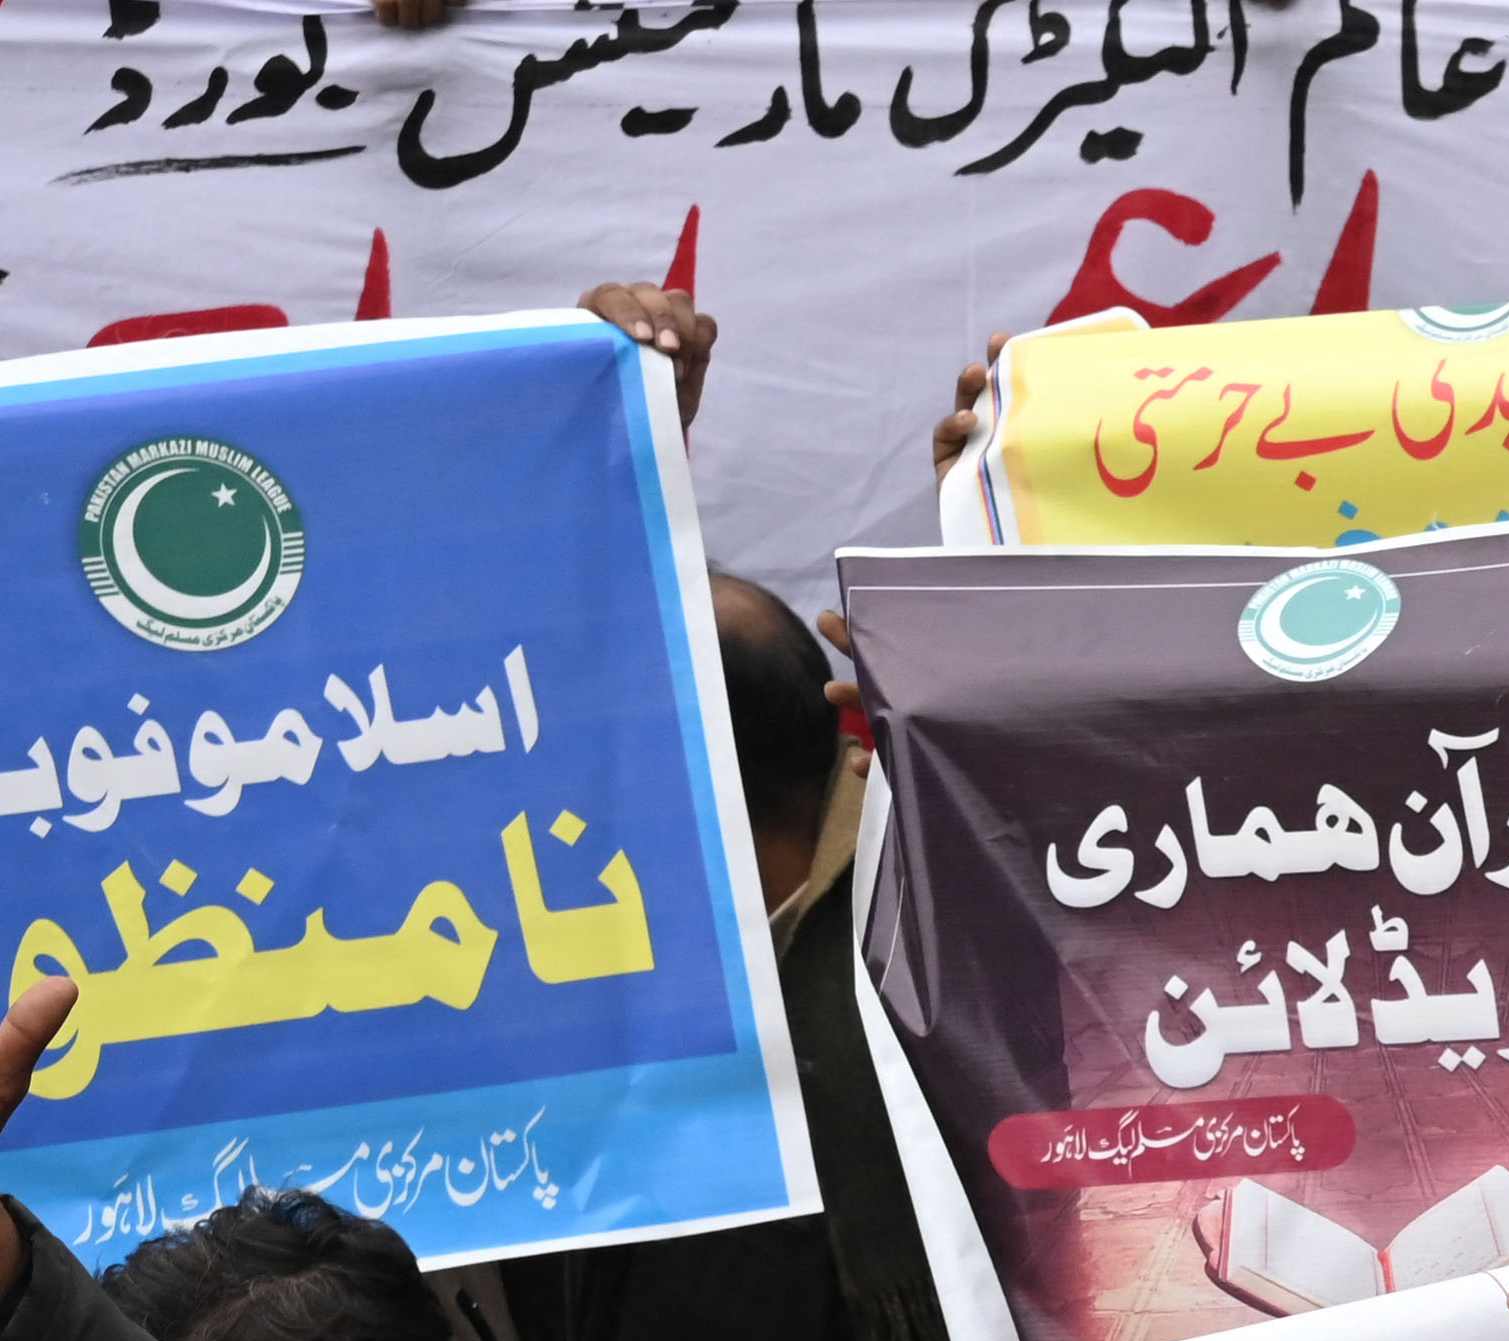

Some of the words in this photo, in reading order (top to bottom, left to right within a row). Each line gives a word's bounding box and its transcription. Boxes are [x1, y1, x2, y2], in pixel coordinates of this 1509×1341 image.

[1093, 364, 1262, 499] حرمتی
[1254, 382, 1377, 493] بے
[84, 460, 131, 524] PAKISTAN
[126, 439, 193, 471] MARKAZI
[196, 439, 255, 474] MUSLIM
[249, 464, 294, 515] LEAGUE
[0, 643, 540, 839] اسلاموفوب
[8, 808, 656, 1101] نامنظو
[1143, 929, 1360, 1091] لائن
[352, 1126, 445, 1221] مرکزی
[444, 1104, 560, 1210] پاکستان
[1040, 1123, 1087, 1164] لاہور
[1087, 1109, 1141, 1165] لیگ
[1128, 1116, 1204, 1178] مسلم
[1192, 1111, 1245, 1162] مرکزی
[1242, 1103, 1306, 1162] پاکستان
[73, 1168, 158, 1247] لاہور
